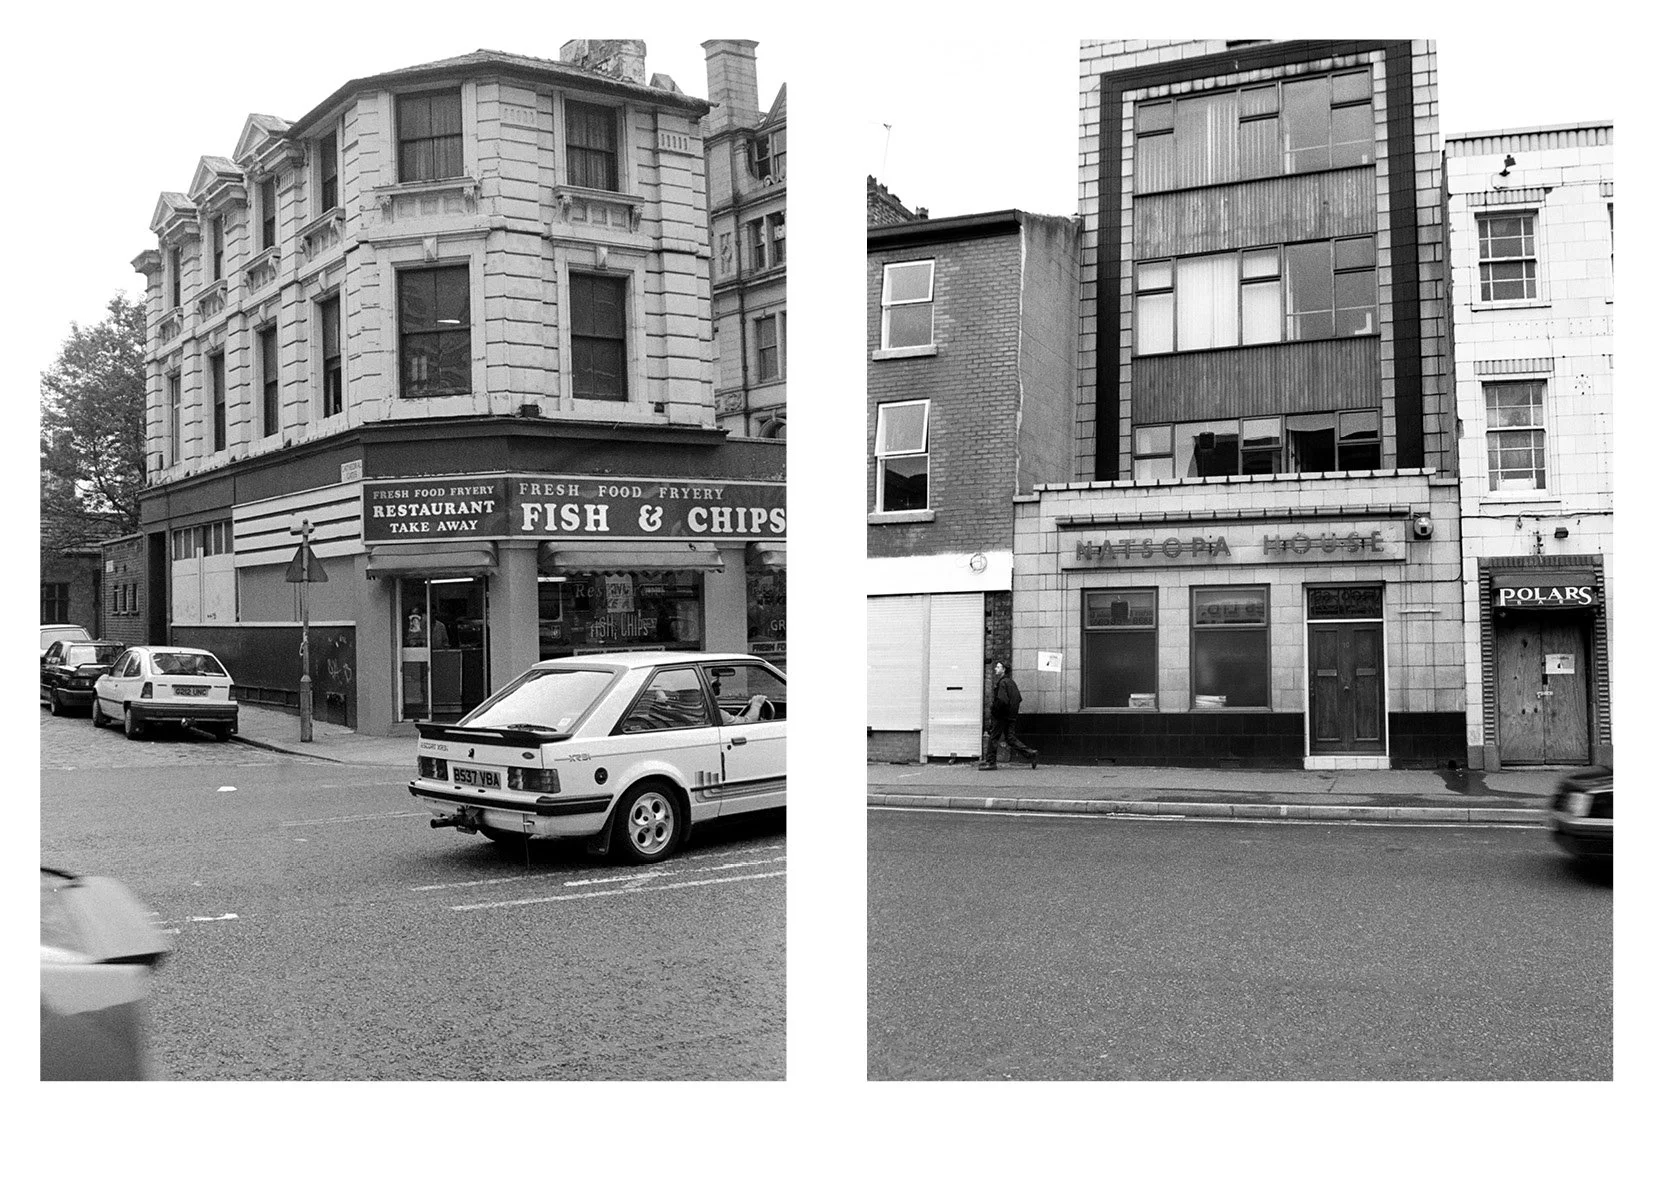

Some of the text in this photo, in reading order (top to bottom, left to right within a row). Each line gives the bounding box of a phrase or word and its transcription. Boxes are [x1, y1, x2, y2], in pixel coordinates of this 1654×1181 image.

[373, 485, 494, 500] FRESH FOOD FRYERY
[518, 483, 724, 500] FRESH FOOD FRYERY
[372, 500, 495, 518] RESTAURANT
[520, 503, 786, 533] FISH & CHIPS
[389, 520, 478, 533] TAKE AWAY
[1076, 530, 1385, 561] NATSOPA HOUSE
[1500, 586, 1592, 607] POLARS
[453, 767, 500, 787] B537 VBA
